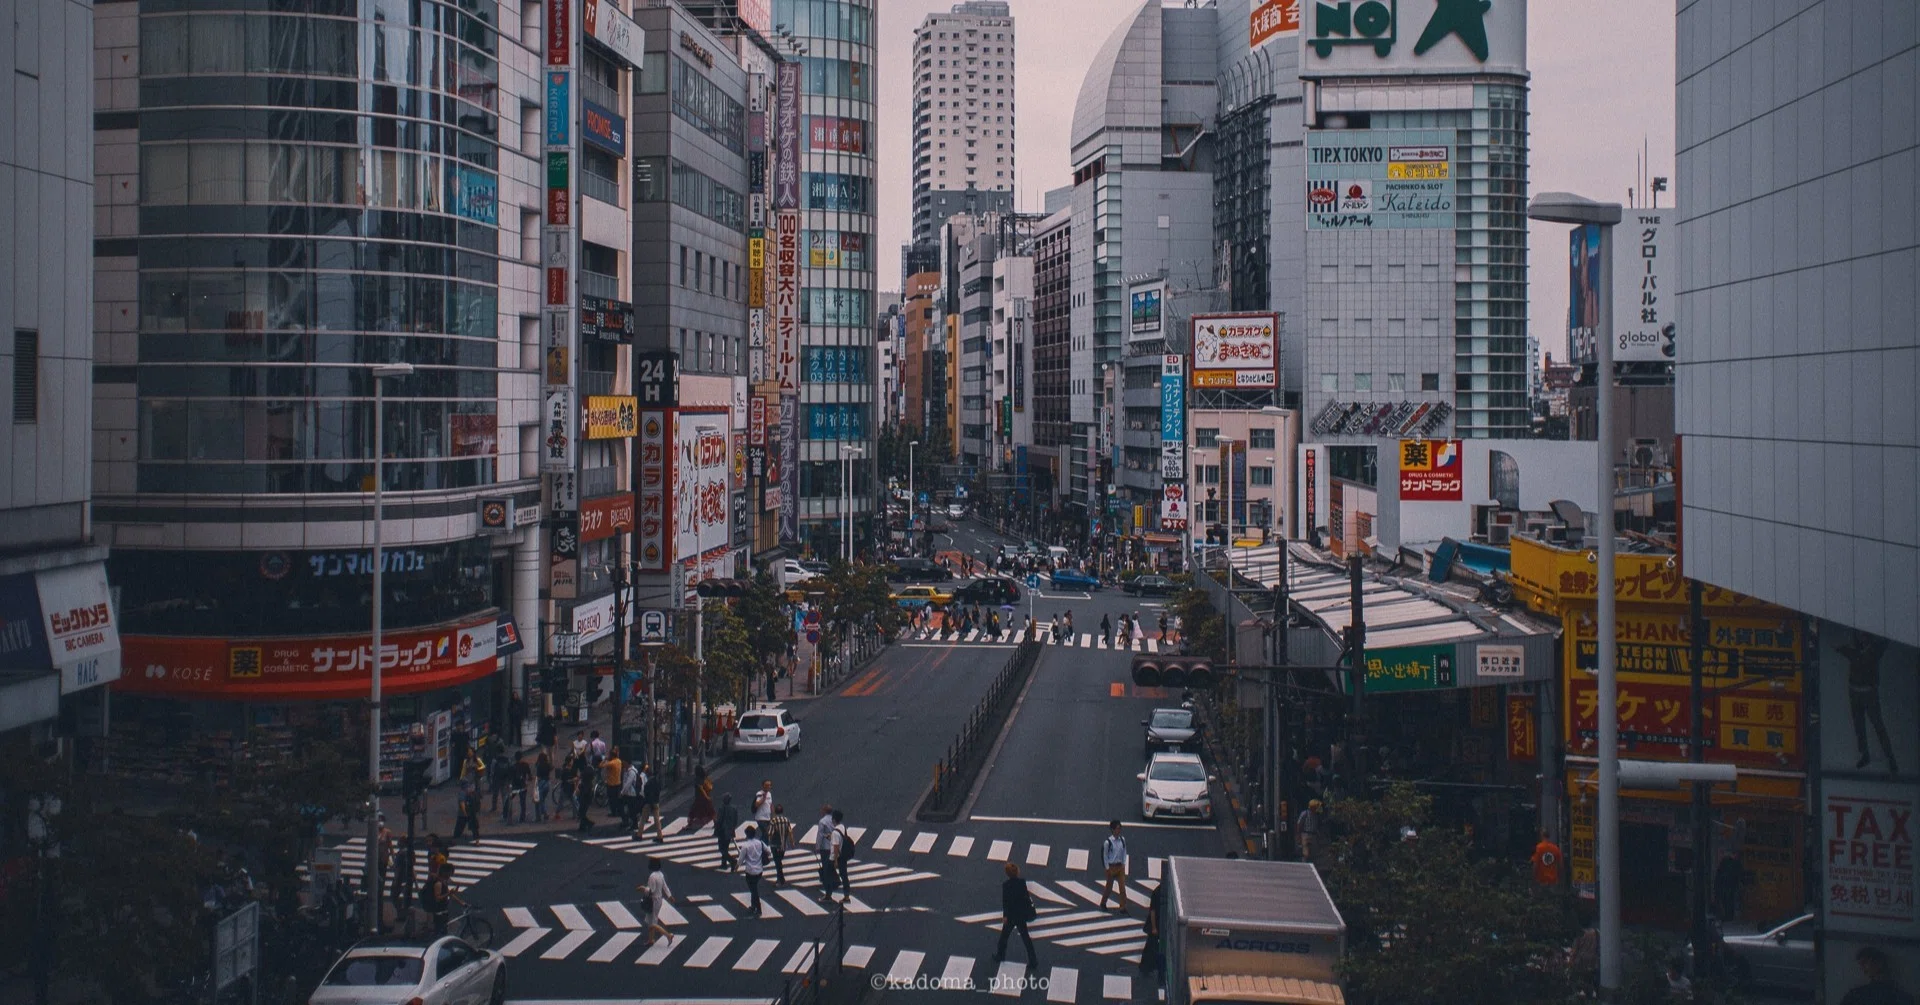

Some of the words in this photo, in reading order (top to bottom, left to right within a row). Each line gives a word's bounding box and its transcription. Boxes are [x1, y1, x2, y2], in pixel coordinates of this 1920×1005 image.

[587, 109, 611, 140] PROMISE
[779, 65, 797, 207] カラオケの鉄人
[1313, 147, 1341, 163] TIP.X
[1343, 147, 1383, 163] TOKYO
[1386, 183, 1419, 191] PACHINKO
[555, 190, 567, 223] 美容室
[1379, 193, 1450, 212] Kaleido
[1638, 216, 1660, 224] THE
[752, 239, 761, 267] 補聴器
[1642, 228, 1657, 324] グローバル社
[778, 214, 796, 389] 100名収容大パーティールーム
[1229, 325, 1262, 337] カラオケ
[1619, 331, 1660, 349] global
[1166, 355, 1178, 364] ED
[1219, 342, 1272, 361] まねきねこ
[641, 359, 665, 383] 24
[1166, 365, 1180, 374] 薄毛
[645, 384, 660, 401] H
[1164, 383, 1172, 432] クリニック
[1172, 378, 1181, 438] ユナイテッド
[752, 400, 764, 442] カラオケ
[750, 447, 765, 457] 24H
[1404, 442, 1428, 467] 薬
[779, 399, 794, 539] カラオケの鉄人
[643, 444, 661, 537] カラオケ
[1401, 479, 1461, 492] サンドラッグ
[1172, 519, 1185, 529] すぐ
[50, 603, 109, 635] ビックカメラ
[65, 638, 77, 652] BIC
[77, 632, 104, 648] CAMERA
[274, 650, 300, 658] DRUG
[311, 640, 433, 673] サンドラッグ
[1480, 656, 1521, 666] 東口近道
[77, 659, 99, 686] HALC
[171, 666, 213, 681] KOSÉ
[264, 664, 309, 673] COSMETIC
[1367, 658, 1431, 681] 思い出横丁
[1732, 702, 1784, 721] 販売
[1511, 701, 1525, 755] チケット
[1828, 804, 1912, 843] TAX
[1828, 839, 1913, 869] FREE
